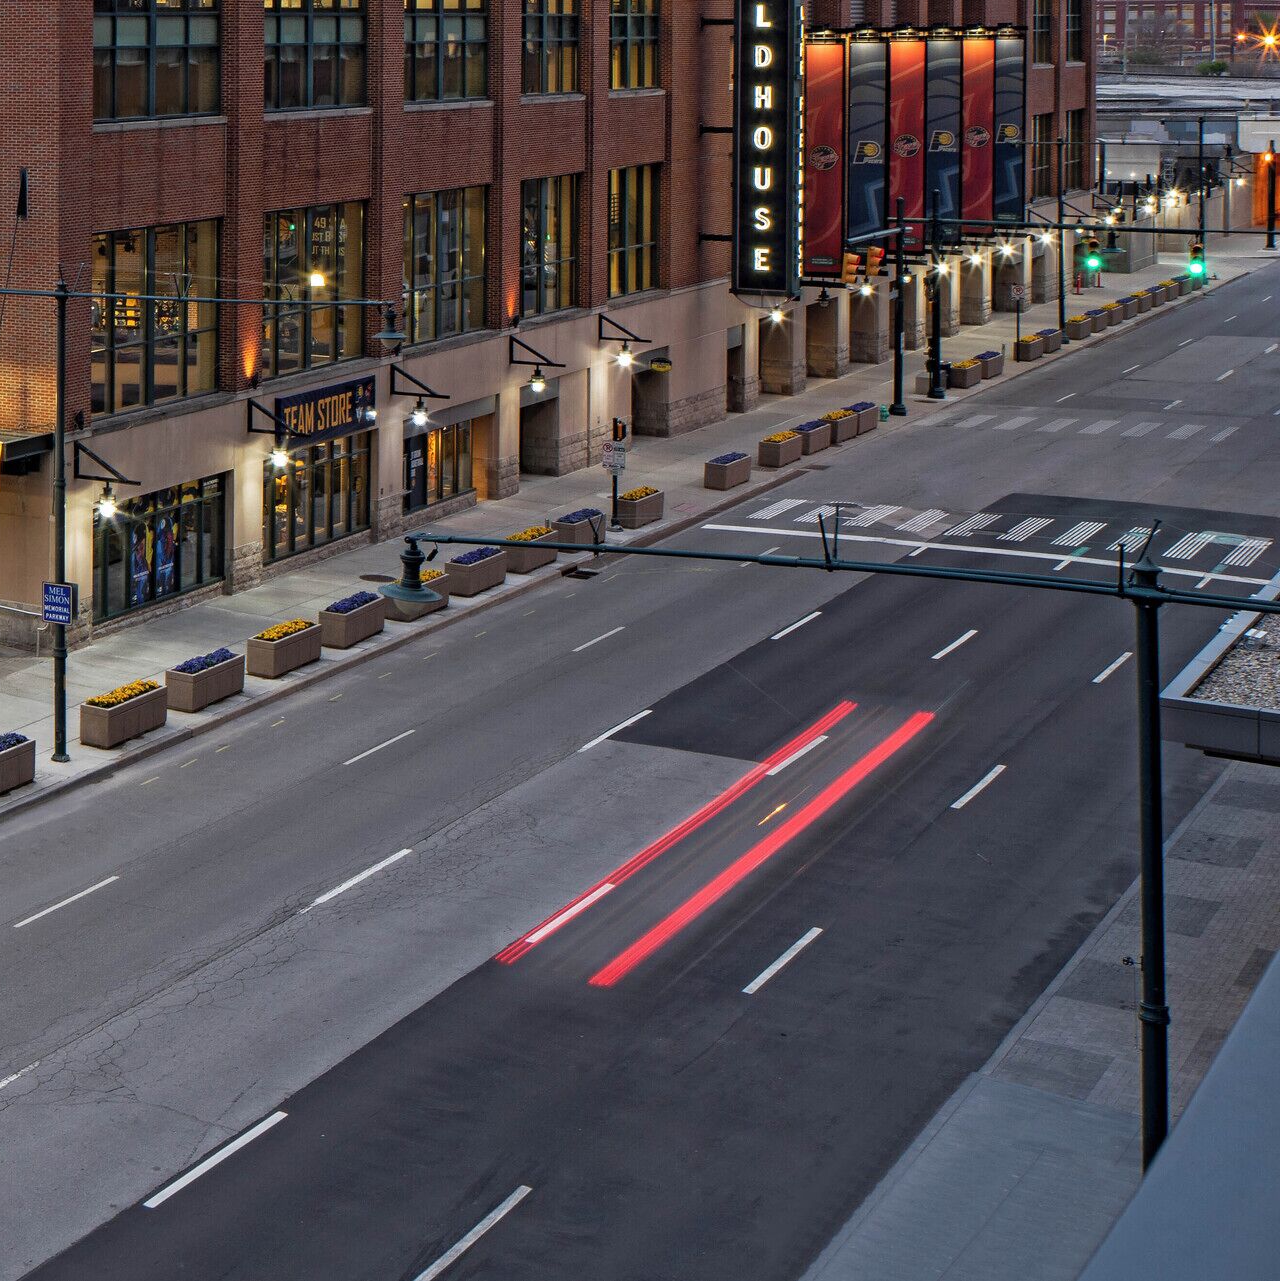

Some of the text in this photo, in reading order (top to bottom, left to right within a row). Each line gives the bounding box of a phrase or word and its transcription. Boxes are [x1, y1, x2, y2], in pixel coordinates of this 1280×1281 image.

[283, 390, 354, 434] TEAM STORE
[48, 586, 66, 597] MEL
[44, 594, 70, 605] SIMON
[44, 604, 70, 614] MEMORIAL
[45, 612, 69, 621] PARKWAY
